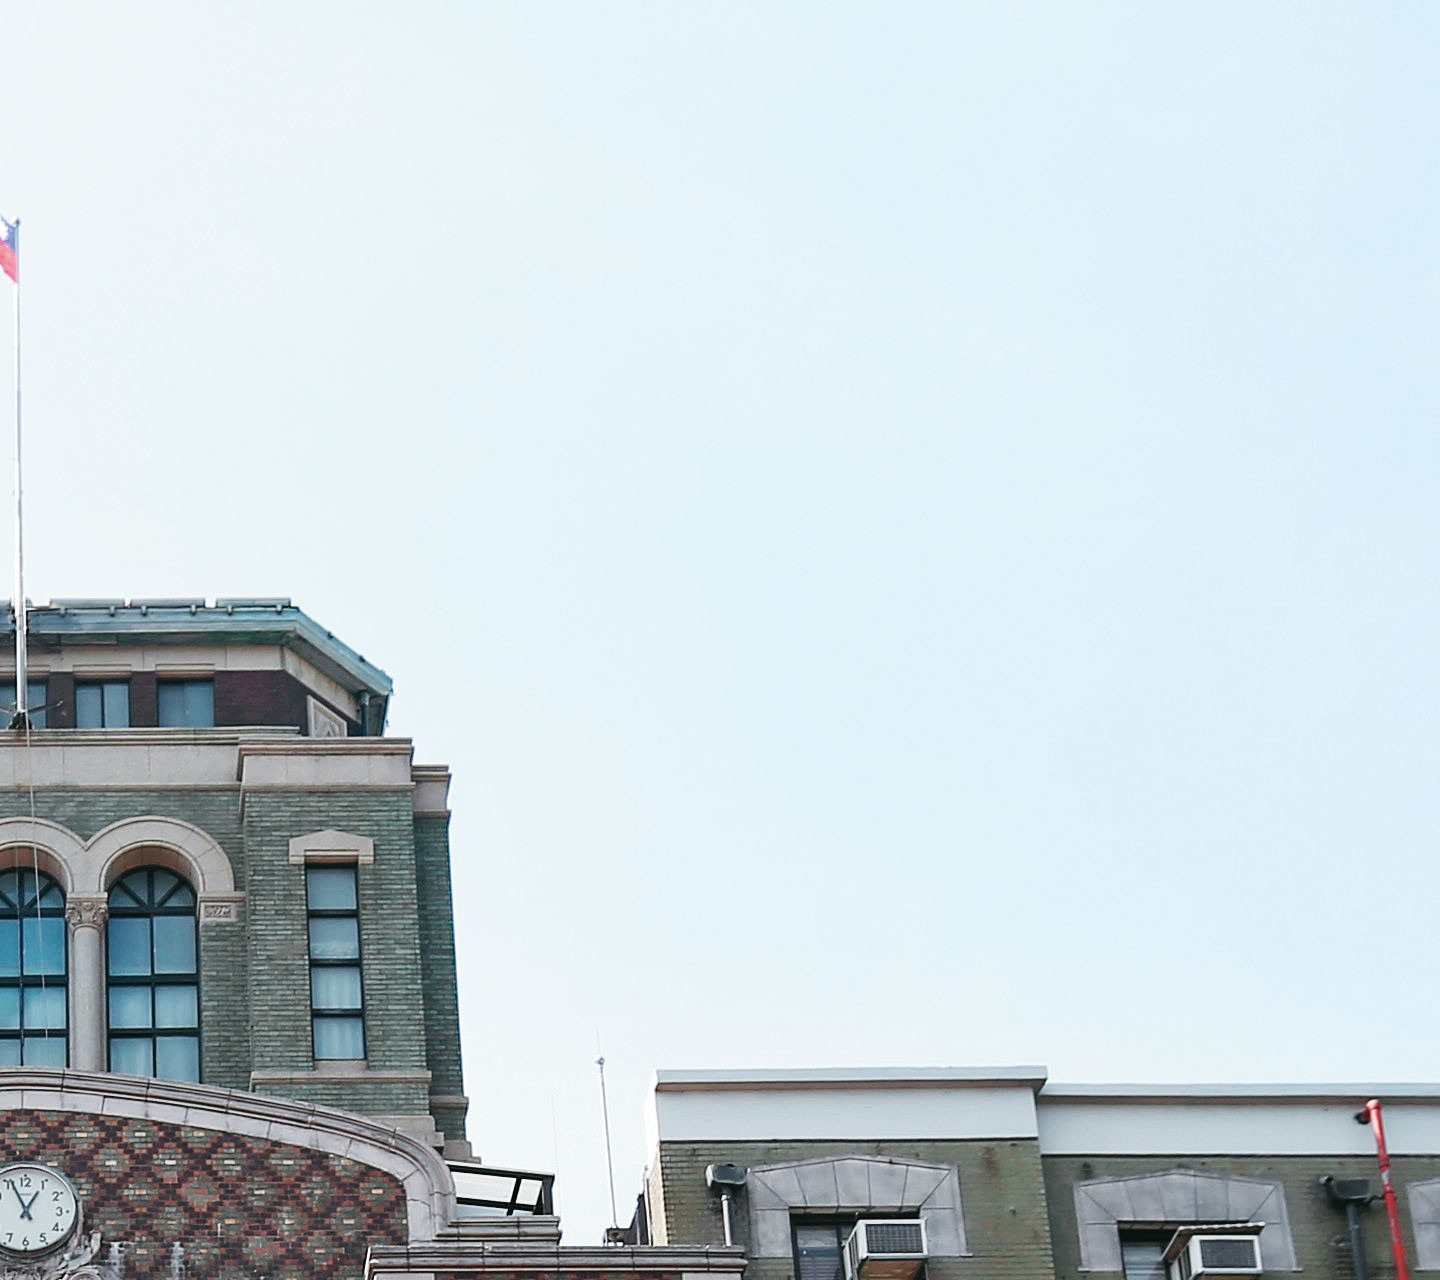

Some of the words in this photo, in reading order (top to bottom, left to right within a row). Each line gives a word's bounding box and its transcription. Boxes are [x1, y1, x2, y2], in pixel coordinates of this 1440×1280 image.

[20, 1177, 31, 1188] 12
[52, 1192, 60, 1201] 2
[56, 1207, 63, 1216] 3
[52, 1222, 59, 1232] 4
[6, 1233, 13, 1242] 7
[22, 1236, 29, 1246] 6
[39, 1233, 47, 1242] 5
